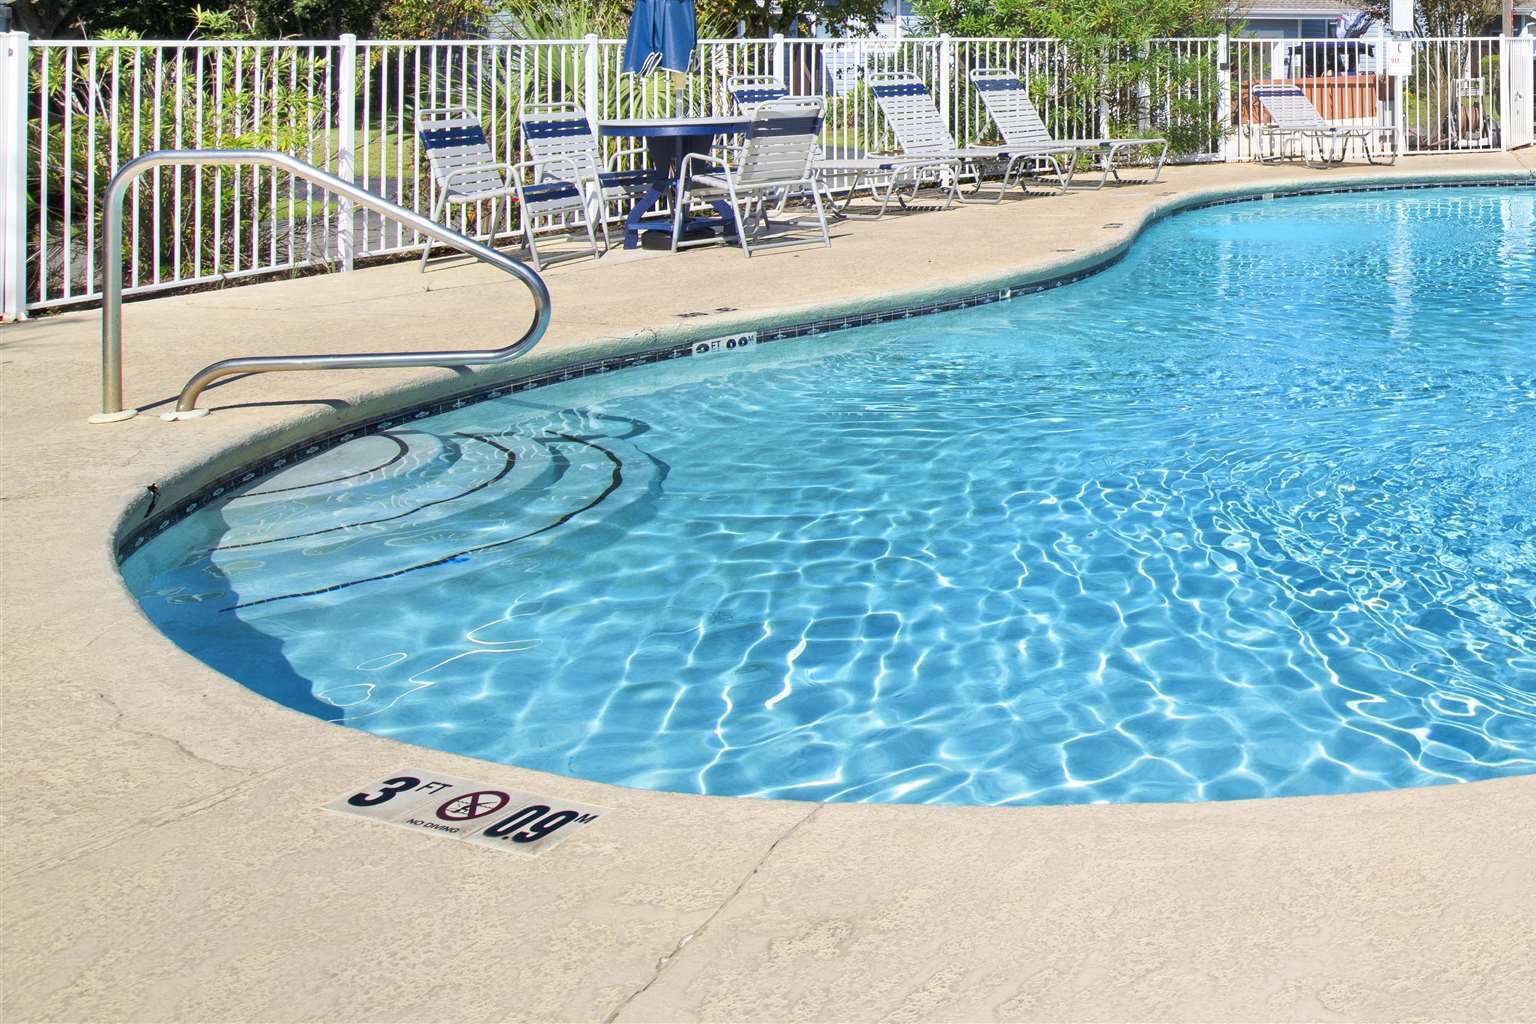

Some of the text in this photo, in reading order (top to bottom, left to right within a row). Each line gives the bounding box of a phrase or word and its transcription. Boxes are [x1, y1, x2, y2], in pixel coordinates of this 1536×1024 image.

[347, 776, 421, 807] 3
[416, 781, 453, 794] FT
[406, 818, 461, 834] NO DIVING
